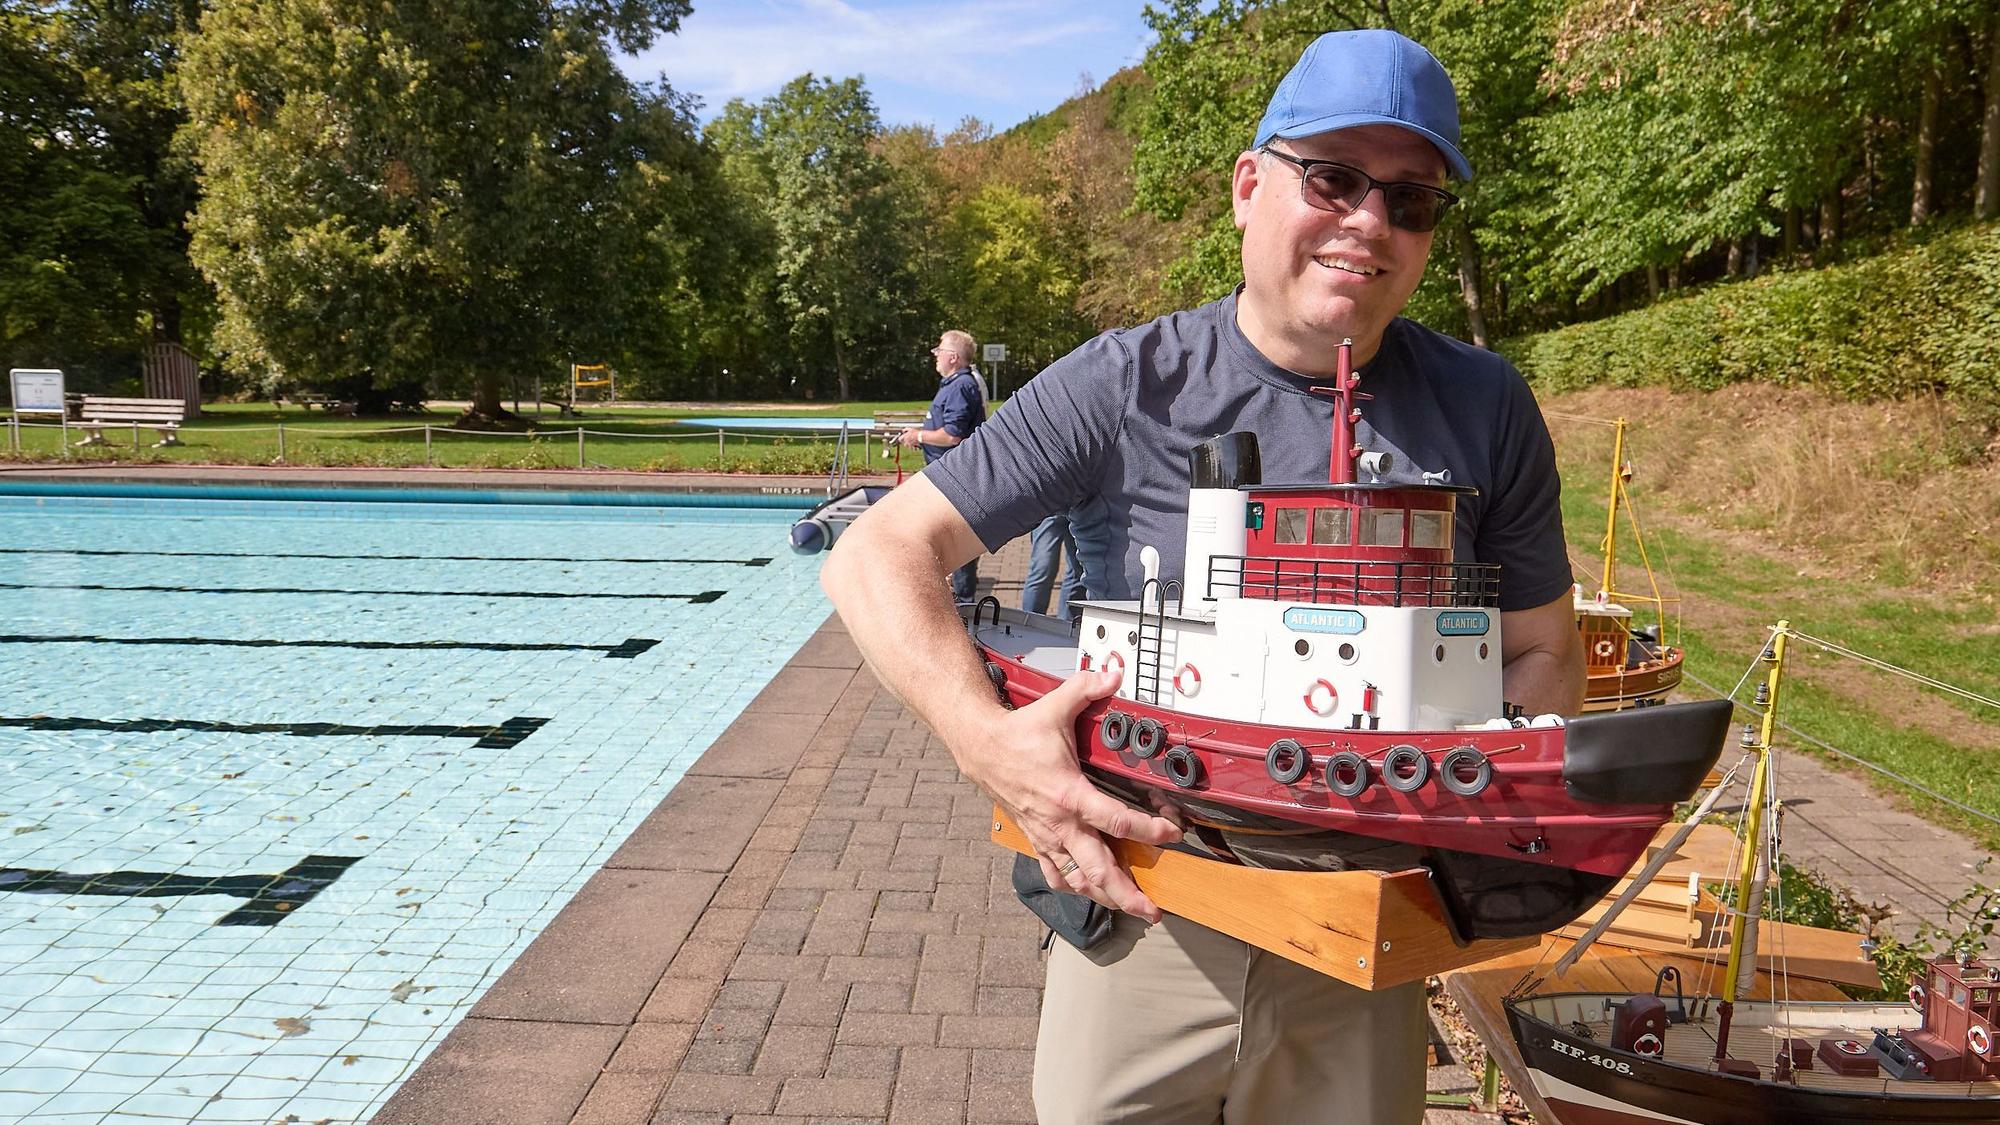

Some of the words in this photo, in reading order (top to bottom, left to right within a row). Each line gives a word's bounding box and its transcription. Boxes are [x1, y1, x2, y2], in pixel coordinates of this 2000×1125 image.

[1290, 613, 1345, 627] ATLANTIC
[1348, 615, 1357, 628] II
[1441, 617, 1478, 629] ATLANTIC
[1479, 618, 1485, 628] II
